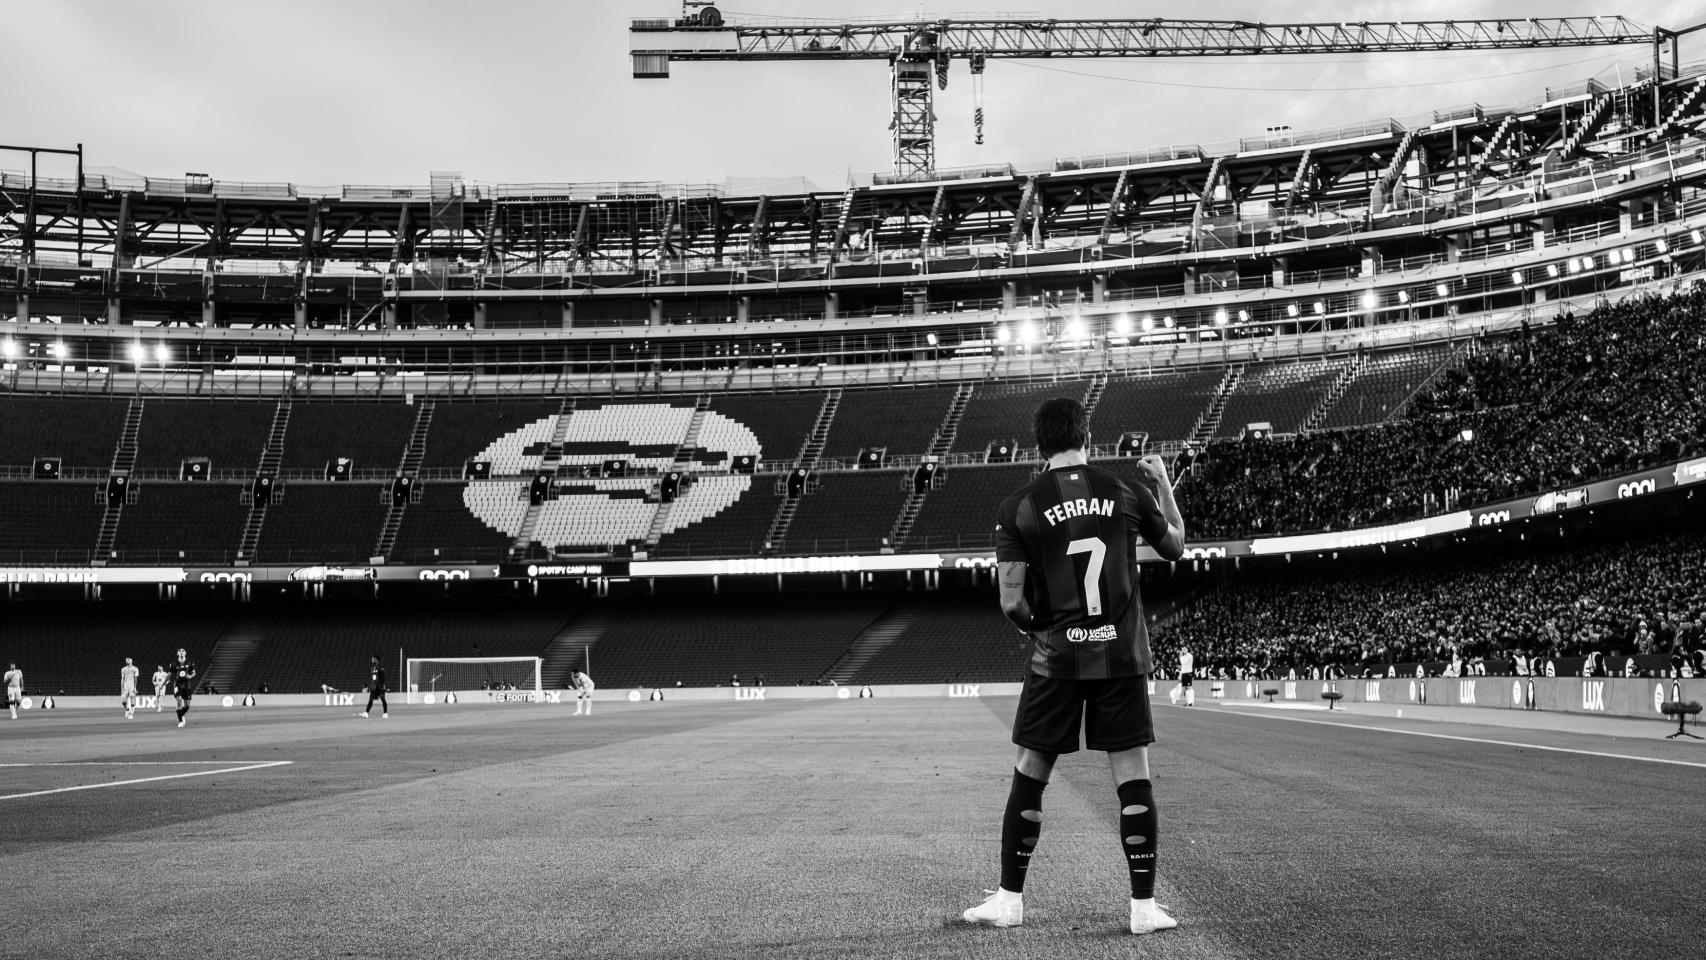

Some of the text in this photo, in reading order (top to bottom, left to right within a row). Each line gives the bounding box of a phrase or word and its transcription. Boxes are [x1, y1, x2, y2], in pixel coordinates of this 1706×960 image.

[1043, 497, 1115, 527] FERRAN
[538, 566, 566, 575] SPOTIFY
[1066, 536, 1107, 617] 7
[735, 687, 766, 700] LUX
[949, 684, 980, 697] LUX
[1366, 680, 1381, 702] LUX
[1460, 679, 1476, 705] LUX
[1583, 681, 1605, 711] LUX
